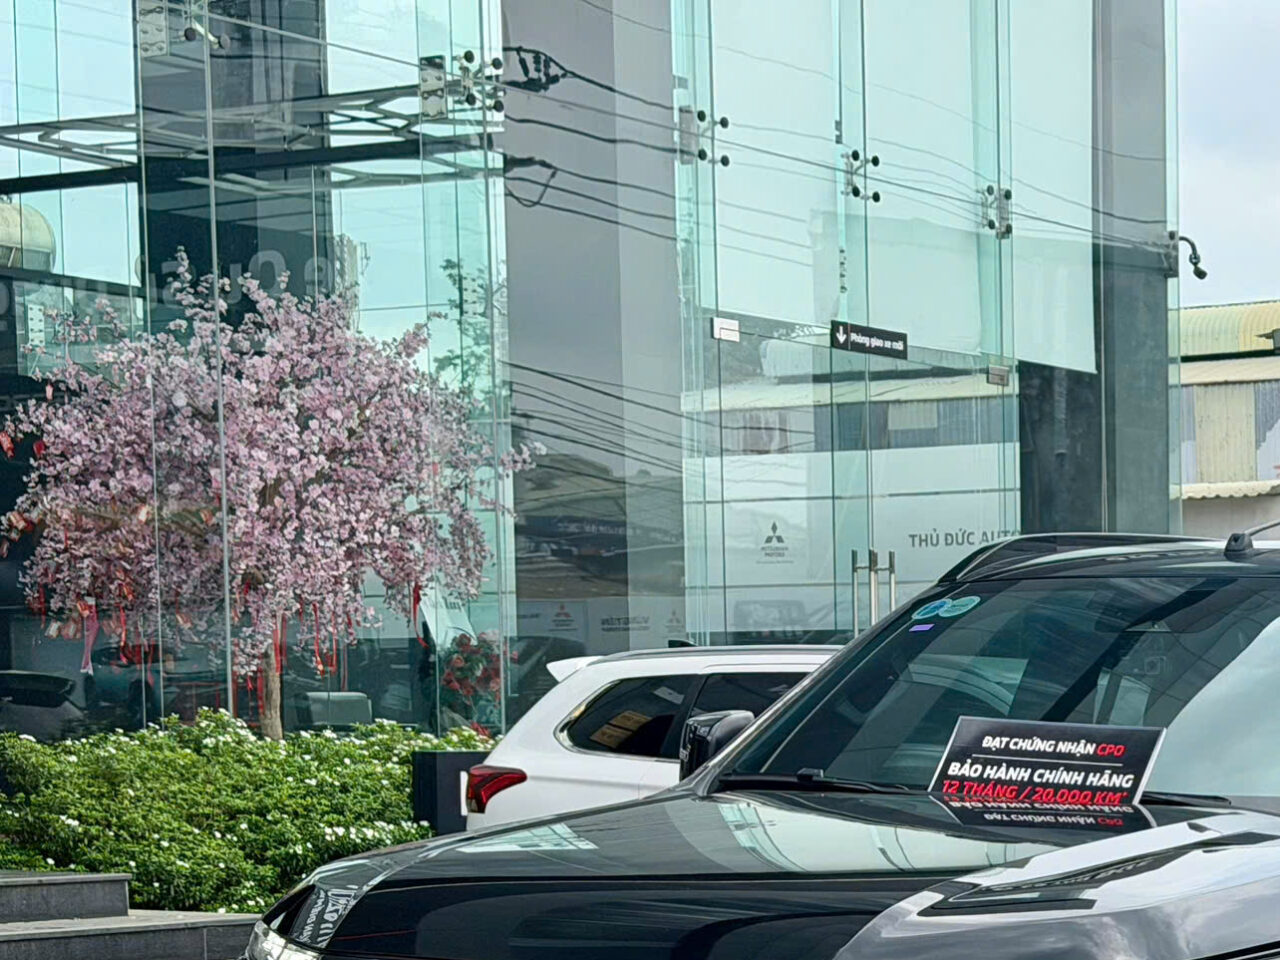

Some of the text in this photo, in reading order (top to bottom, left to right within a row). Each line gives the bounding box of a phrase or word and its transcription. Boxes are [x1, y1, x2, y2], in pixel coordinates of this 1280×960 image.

[908, 528, 940, 548] THỦ
[944, 527, 975, 547] ĐỨC
[982, 735, 1126, 758] ĐẠT CHỨNG NHẬN CPO
[947, 758, 1135, 788] BẢO HÀNH CHÍNH HÃNG
[942, 780, 960, 794] 12
[962, 780, 1018, 799] THÁNG
